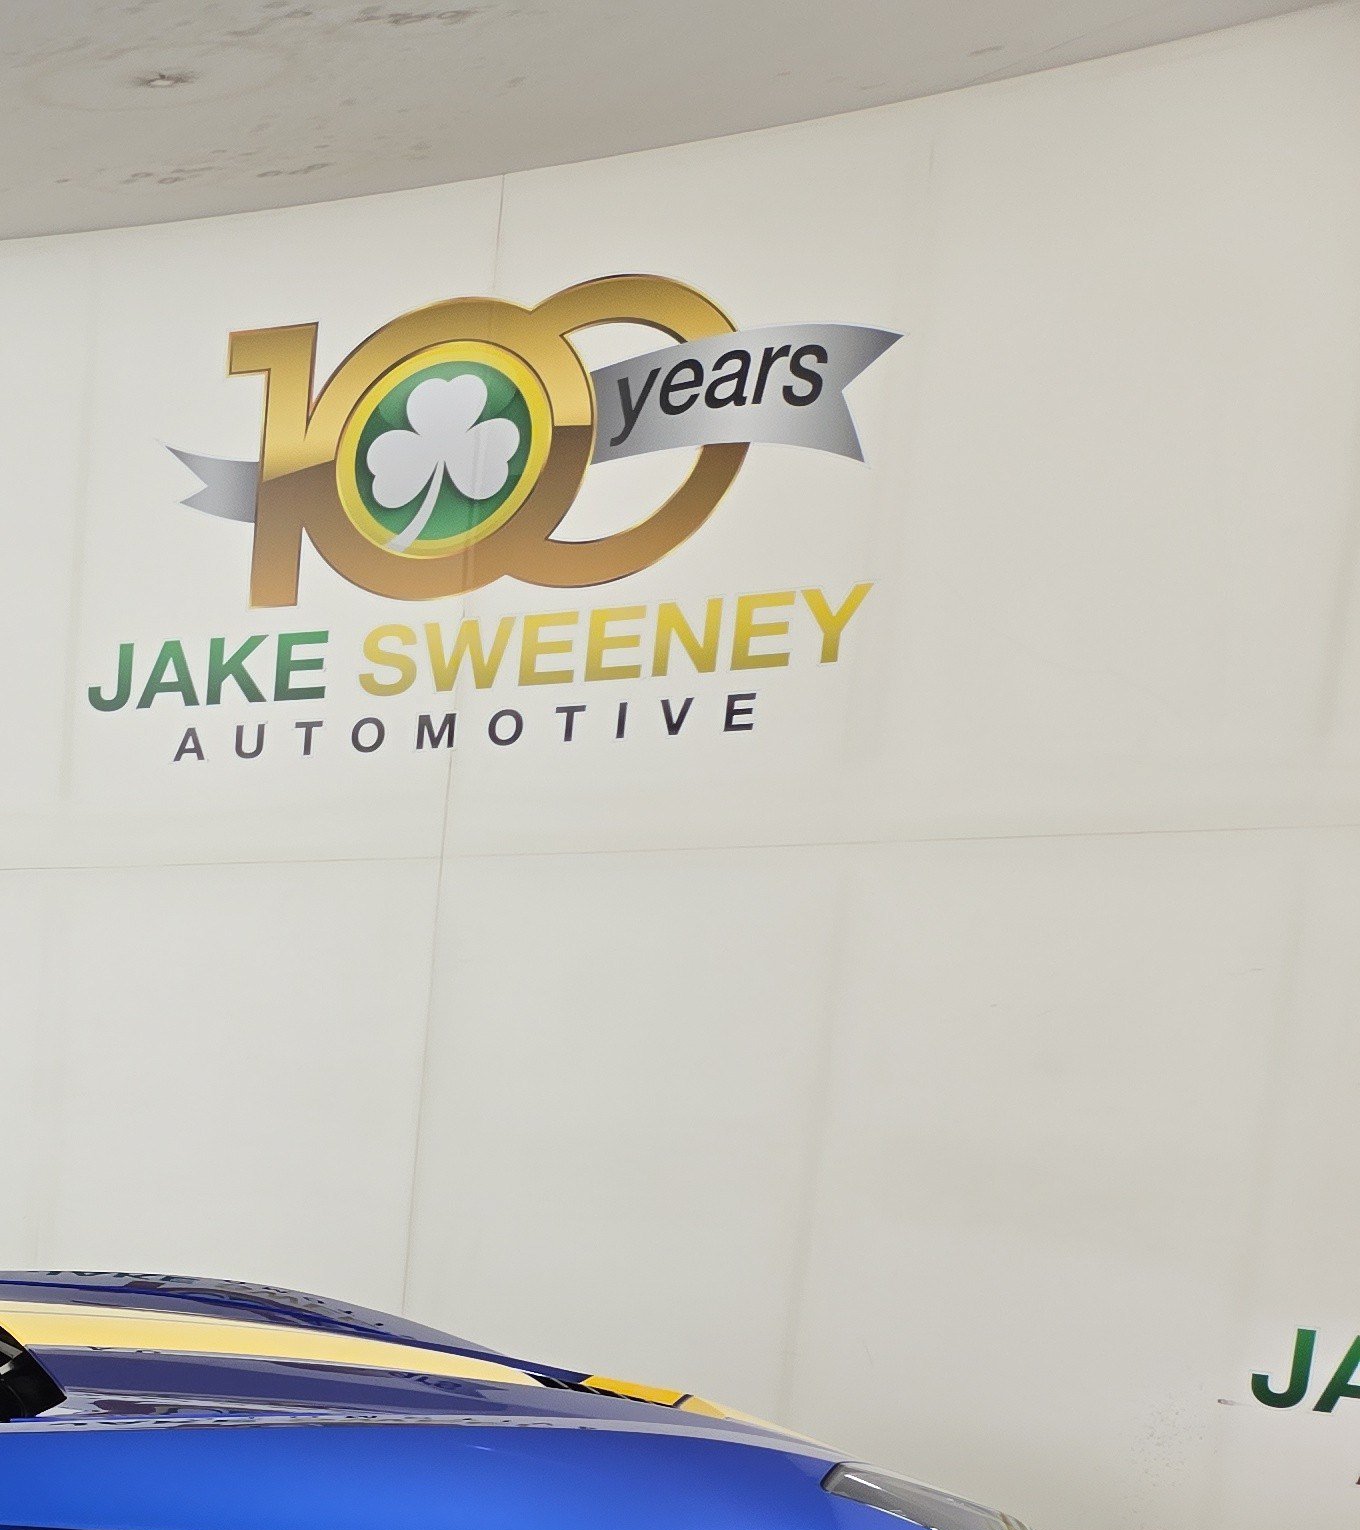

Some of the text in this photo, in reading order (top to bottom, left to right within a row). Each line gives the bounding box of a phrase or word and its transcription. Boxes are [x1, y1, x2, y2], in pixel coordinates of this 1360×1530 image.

[227, 274, 829, 609] 100 years
[87, 582, 875, 713] JAKE SWEENEY
[173, 692, 758, 763] AUTOMOTIVE
